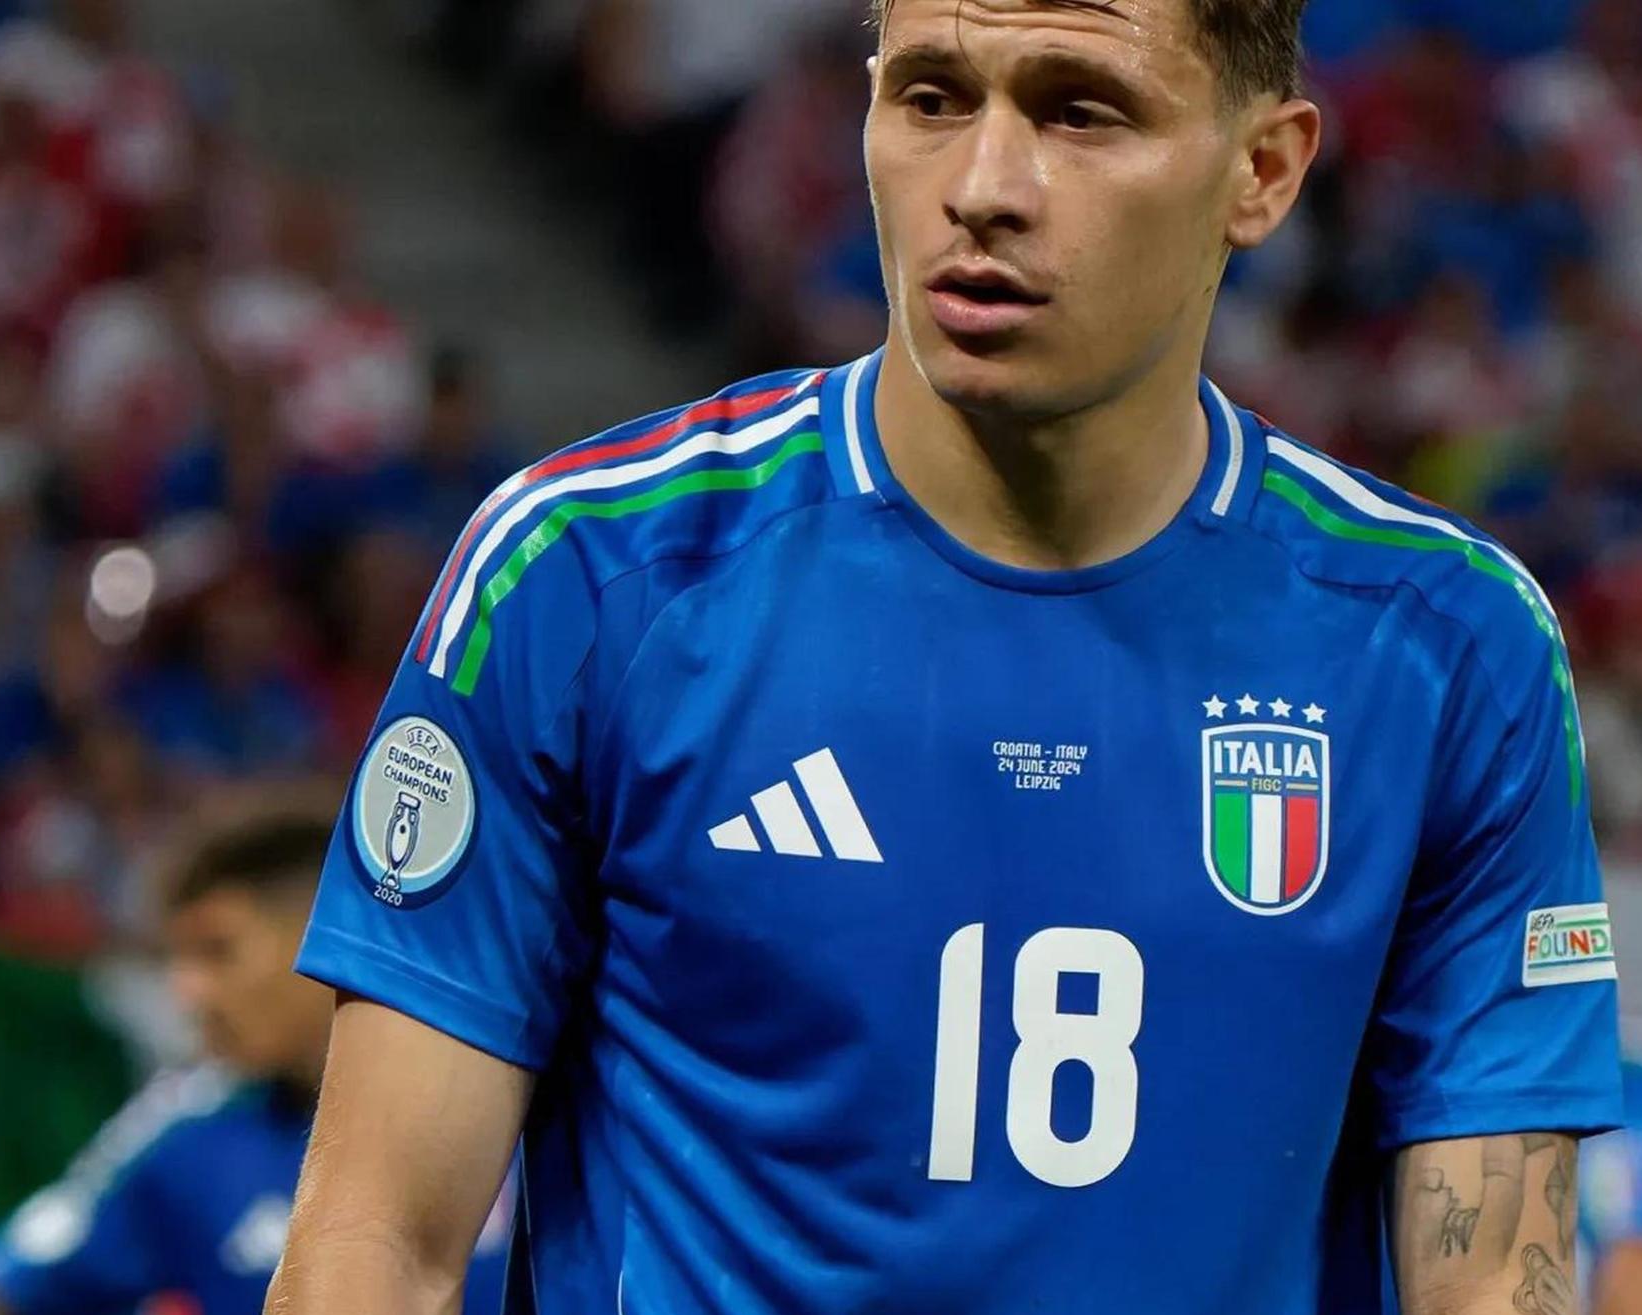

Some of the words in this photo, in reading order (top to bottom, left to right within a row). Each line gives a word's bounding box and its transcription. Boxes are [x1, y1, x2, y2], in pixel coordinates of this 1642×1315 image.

[406, 729, 440, 756] UEFA
[993, 741, 1042, 758] CROATIA
[1055, 745, 1088, 760] ITALY
[387, 745, 453, 786] EUROPEAN
[997, 757, 1014, 772] 24
[1016, 758, 1046, 774] JUNE
[1048, 760, 1081, 776] 2024
[1212, 740, 1319, 779] ITALIA
[382, 763, 449, 803] CHAMPIONS
[1015, 774, 1062, 791] LEIPZIG
[1251, 777, 1283, 793] FIGC
[373, 884, 404, 907] 2020
[1527, 928, 1611, 962] FOUND
[927, 922, 1145, 1188] 18
